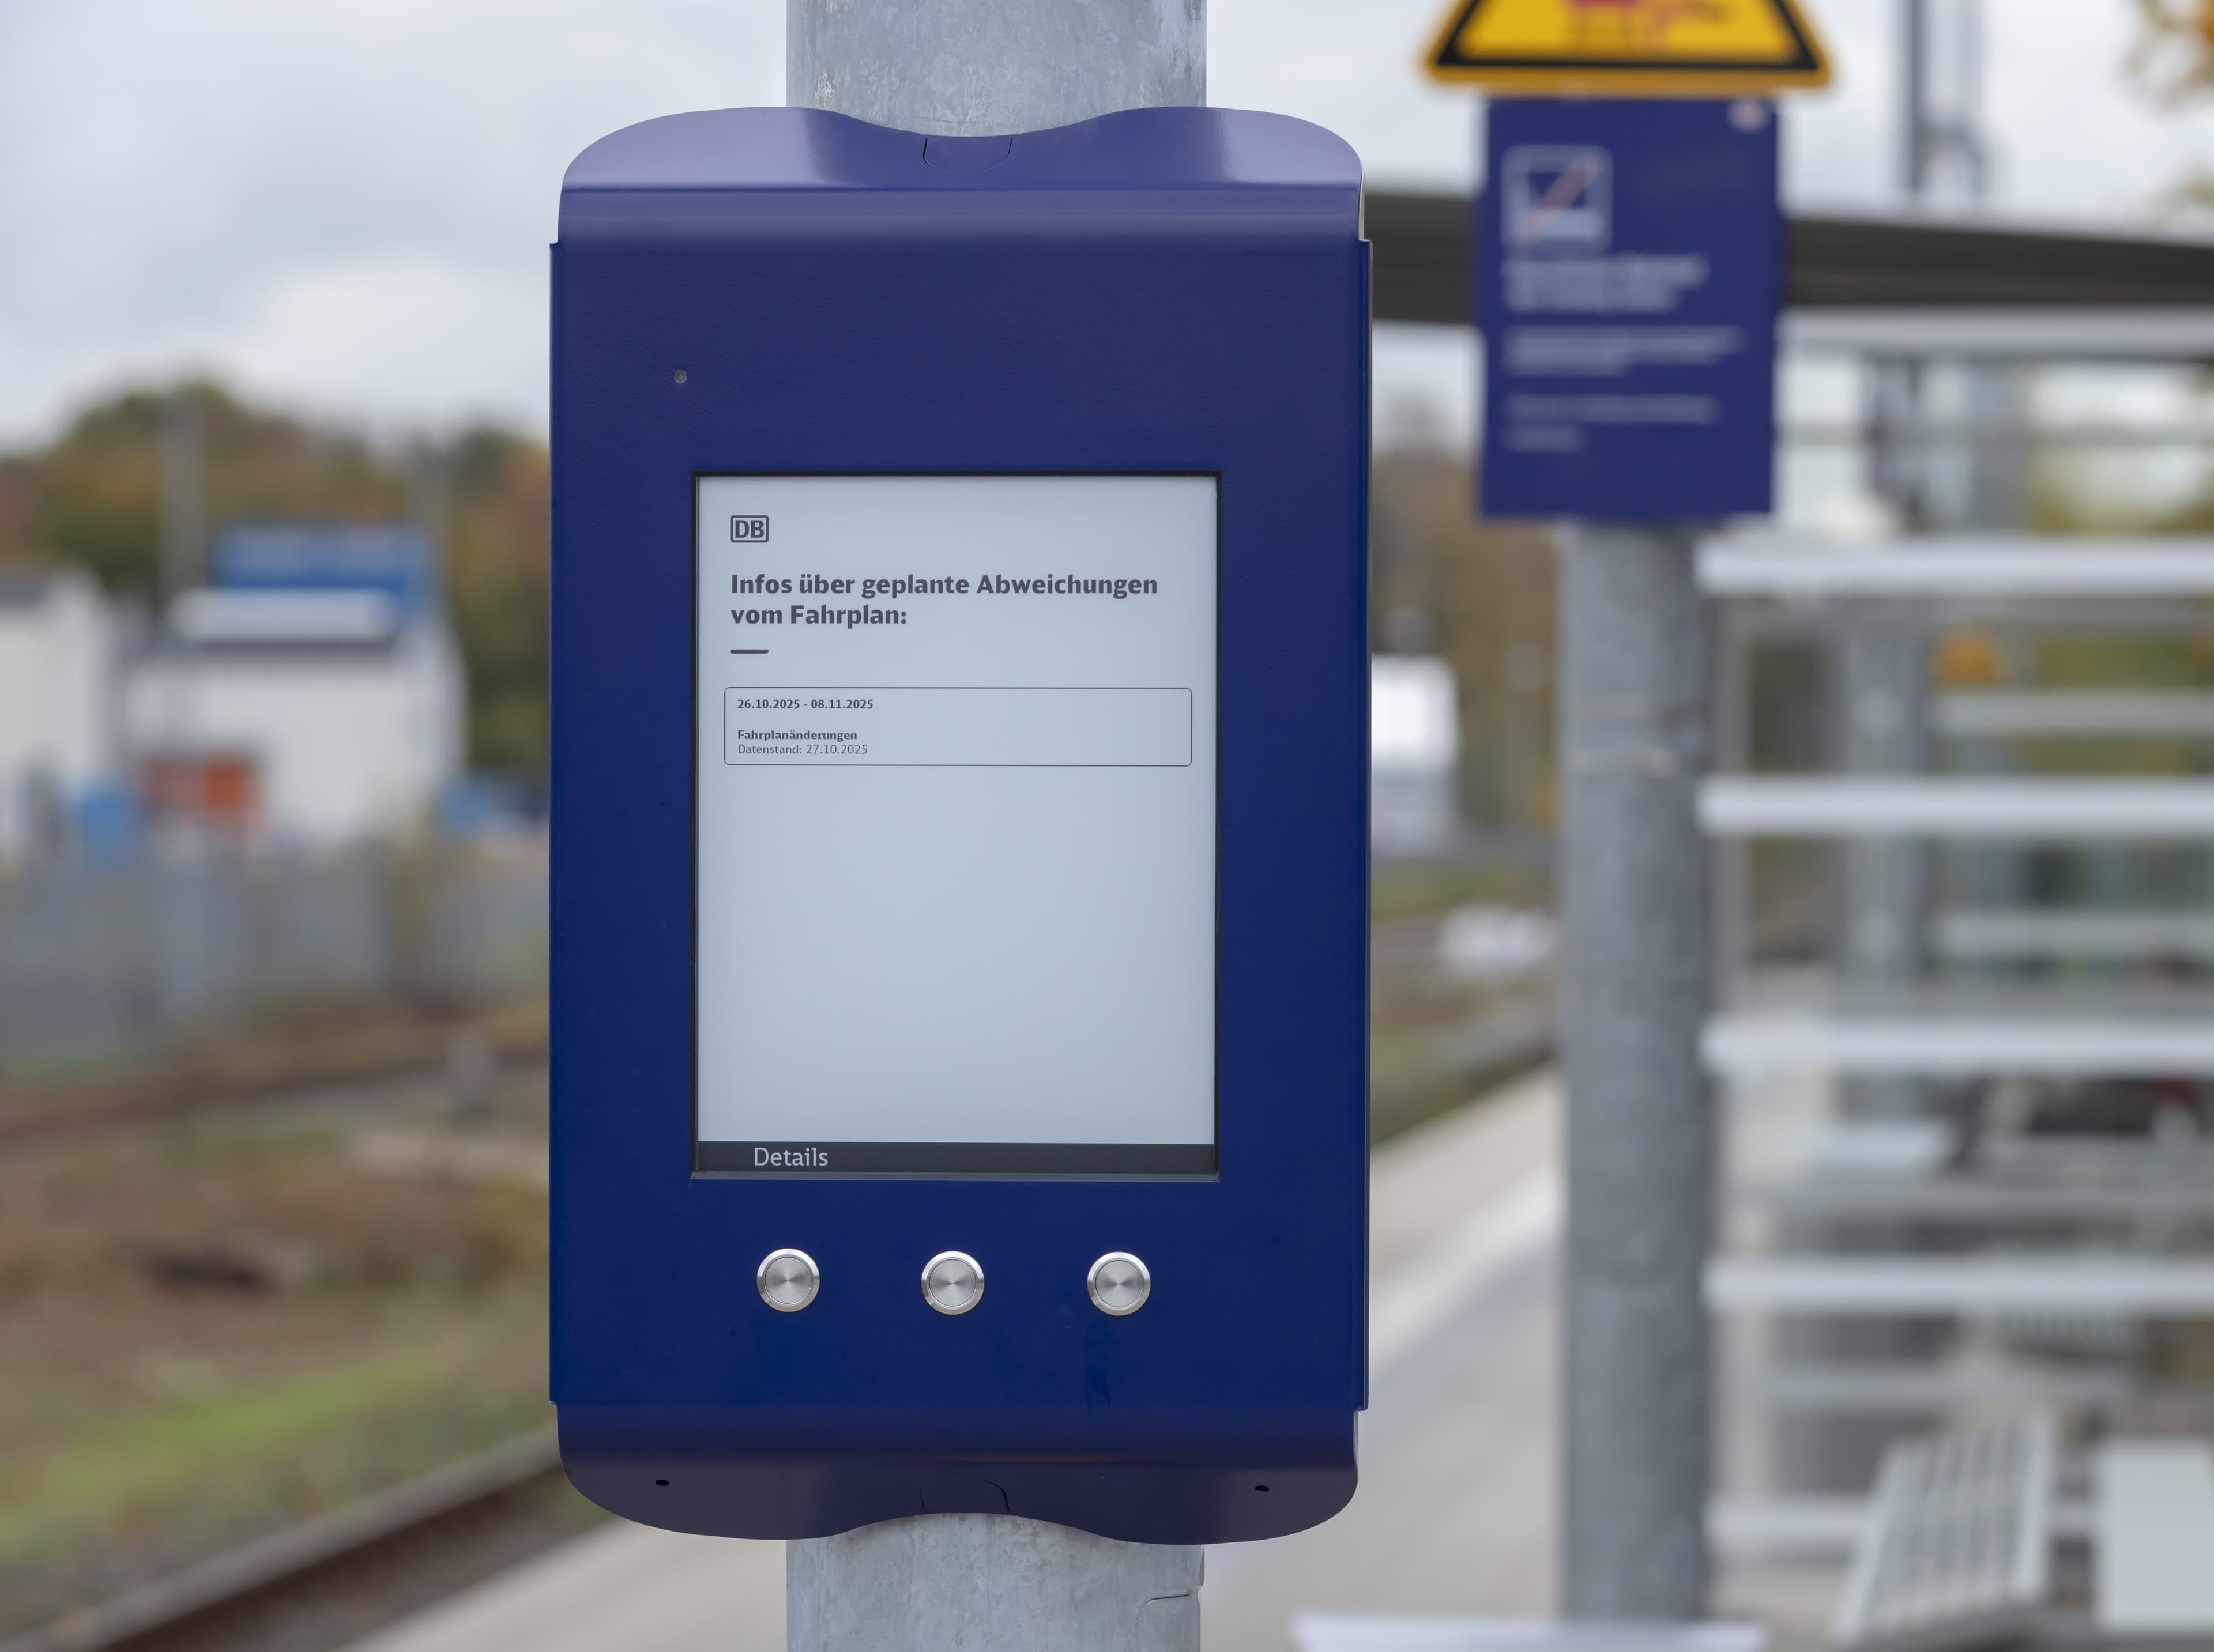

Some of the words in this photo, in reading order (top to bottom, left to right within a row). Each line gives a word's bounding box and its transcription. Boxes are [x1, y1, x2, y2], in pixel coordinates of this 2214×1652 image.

[734, 519, 765, 539] DB
[731, 573, 793, 595] Infos
[799, 573, 856, 594] über
[861, 573, 970, 599] geplante
[976, 573, 1158, 600] Abweichungen
[730, 608, 784, 625] vom
[790, 604, 908, 629] Fahrplan:
[737, 699, 800, 710] 26.10.2025
[810, 699, 873, 710] 08.11.2025
[737, 729, 857, 742] Fahrplanänderungen
[738, 744, 802, 755] Datenstand:
[806, 744, 868, 755] 27.10.2025
[754, 1146, 829, 1167] Details
